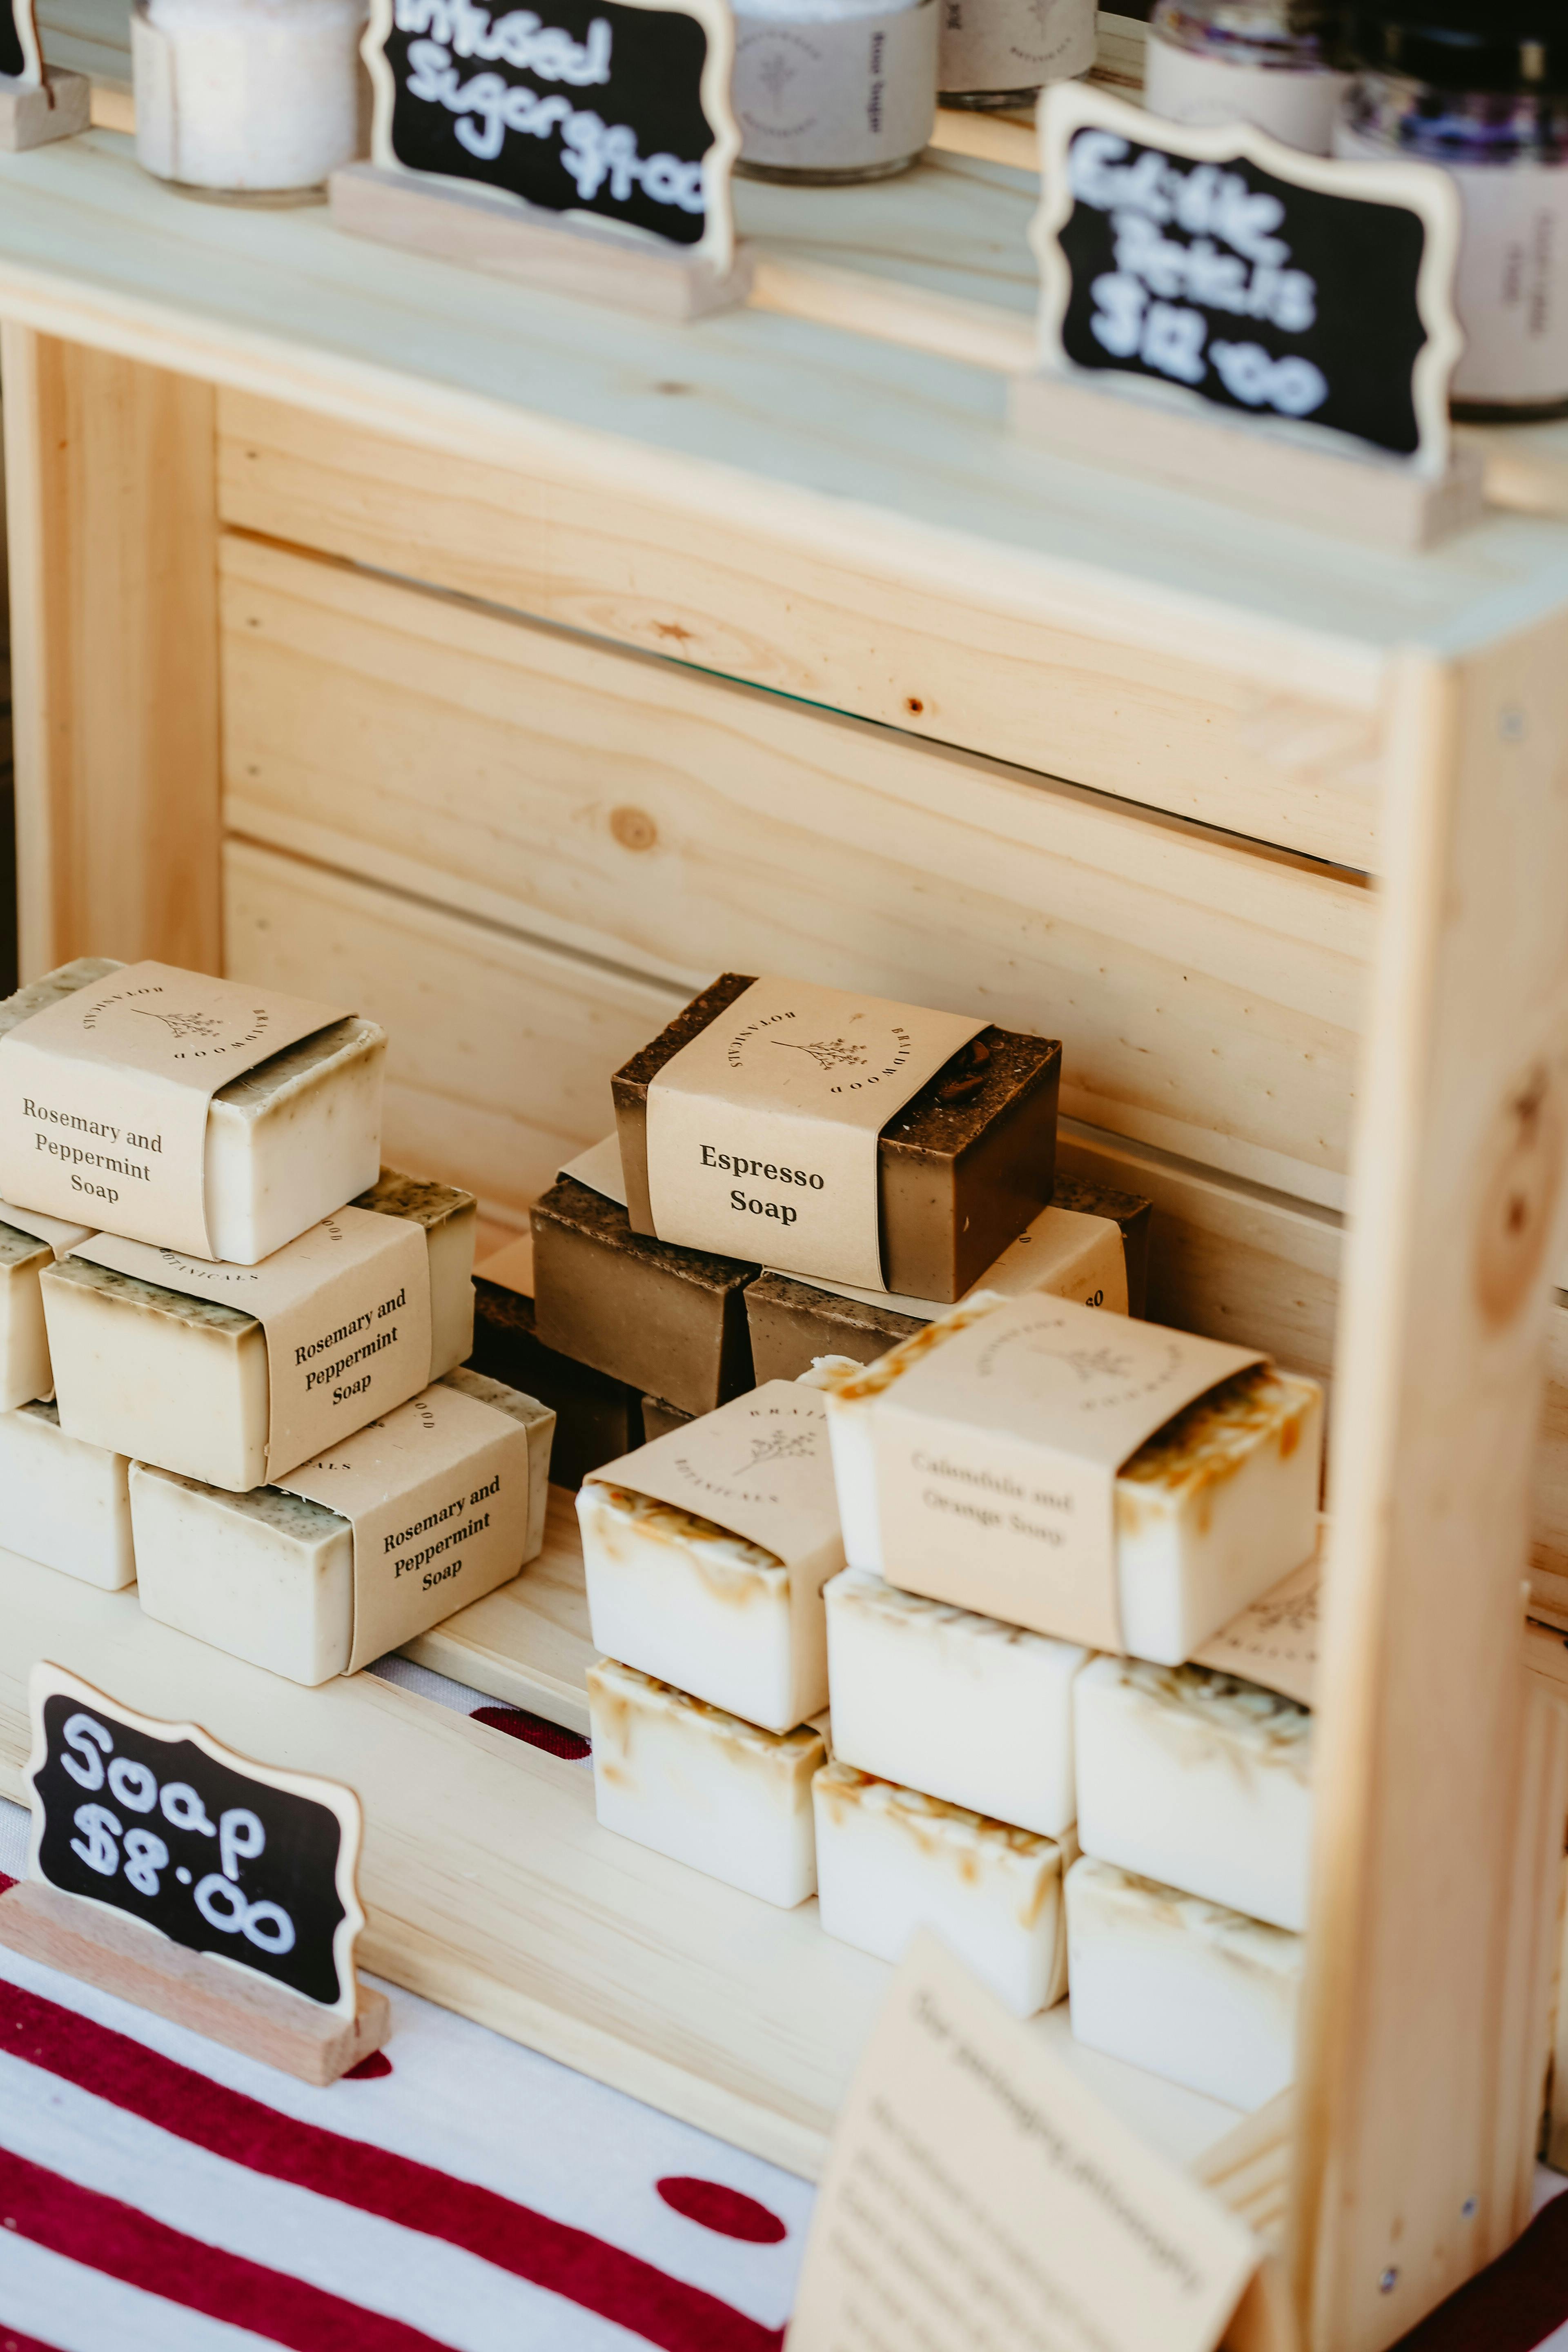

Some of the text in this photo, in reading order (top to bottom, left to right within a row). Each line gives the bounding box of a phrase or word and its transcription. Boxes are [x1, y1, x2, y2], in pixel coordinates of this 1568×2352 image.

[83, 987, 163, 1029] BOTANICALS
[174, 1009, 268, 1059] BRAIDWOOD
[728, 1012, 795, 1067] BOTANICALS
[831, 1028, 911, 1093] BRAIDWOOD
[22, 1098, 162, 1154] Rosemary and
[34, 1133, 150, 1182] Peppermint
[699, 1144, 825, 1190] Espresso
[71, 1174, 119, 1204] Soap
[731, 1190, 797, 1225] Soap
[294, 1288, 406, 1366] Rosemary and
[305, 1325, 398, 1391] Peppermint
[332, 1374, 372, 1405] Soap
[912, 1450, 1073, 1516] Calendula and
[383, 1474, 500, 1554] Rosemary and
[923, 1488, 1065, 1547] Orange Soap
[394, 1513, 490, 1578] Peppermint
[422, 1560, 462, 1591] Soap
[60, 1713, 265, 1881] Soap
[70, 1803, 295, 1954] $8.00
